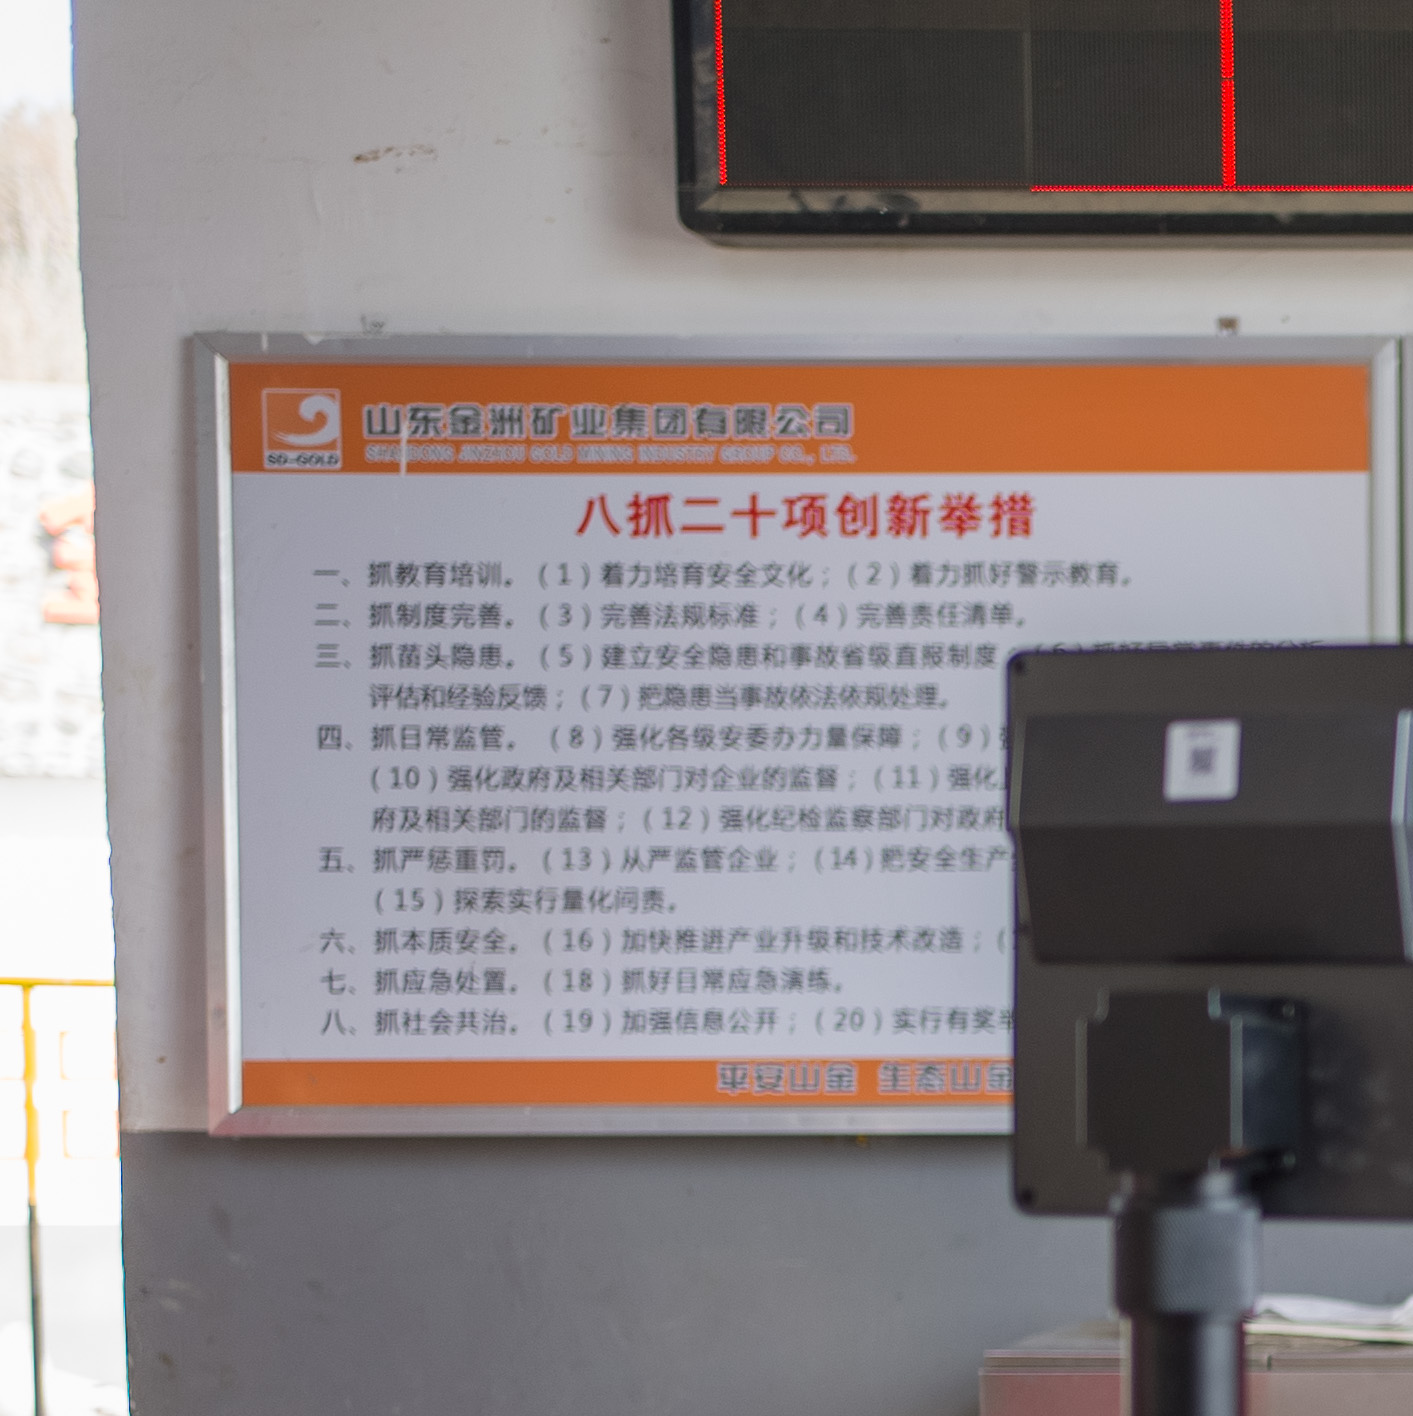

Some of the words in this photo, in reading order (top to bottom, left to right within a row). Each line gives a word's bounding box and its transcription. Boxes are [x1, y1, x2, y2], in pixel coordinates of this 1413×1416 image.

[363, 403, 855, 440] 山东金洲矿业集团有限公司
[576, 492, 1034, 540] 八抓二十项创新举措
[717, 1062, 857, 1095] 平安山金
